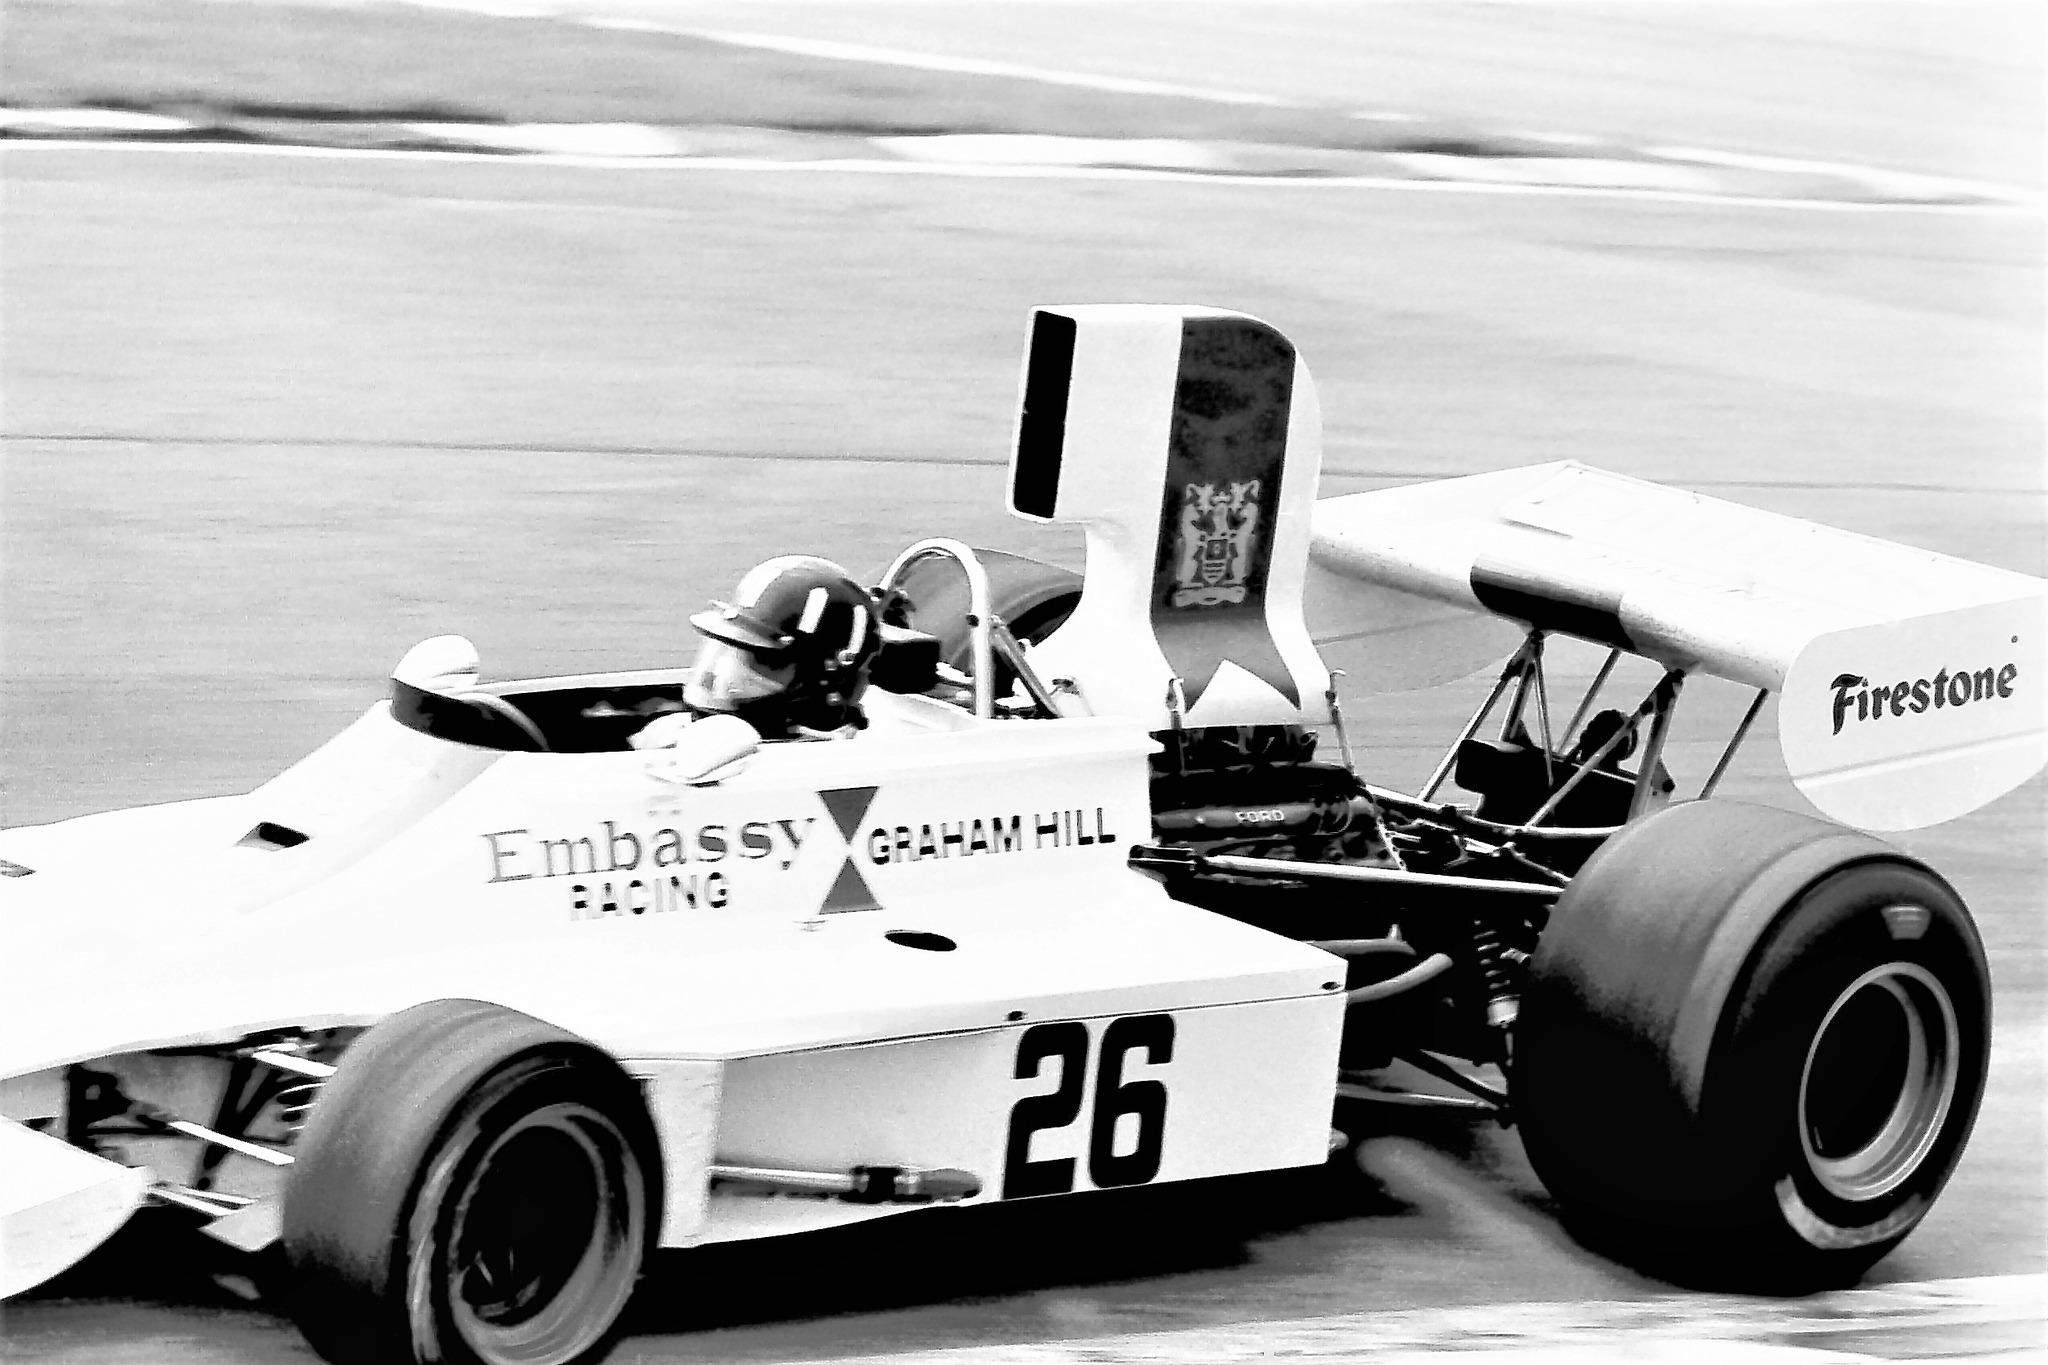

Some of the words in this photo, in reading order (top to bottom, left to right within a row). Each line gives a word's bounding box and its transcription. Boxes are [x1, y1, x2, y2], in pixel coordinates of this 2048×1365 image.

[1830, 663, 2018, 736] Firestone
[868, 814, 1023, 865] GRAHAM
[1034, 807, 1116, 849] HILL
[1236, 810, 1285, 824] FORD
[481, 818, 817, 884] Embassy
[572, 872, 729, 920] RACING
[1002, 1014, 1176, 1200] 26
